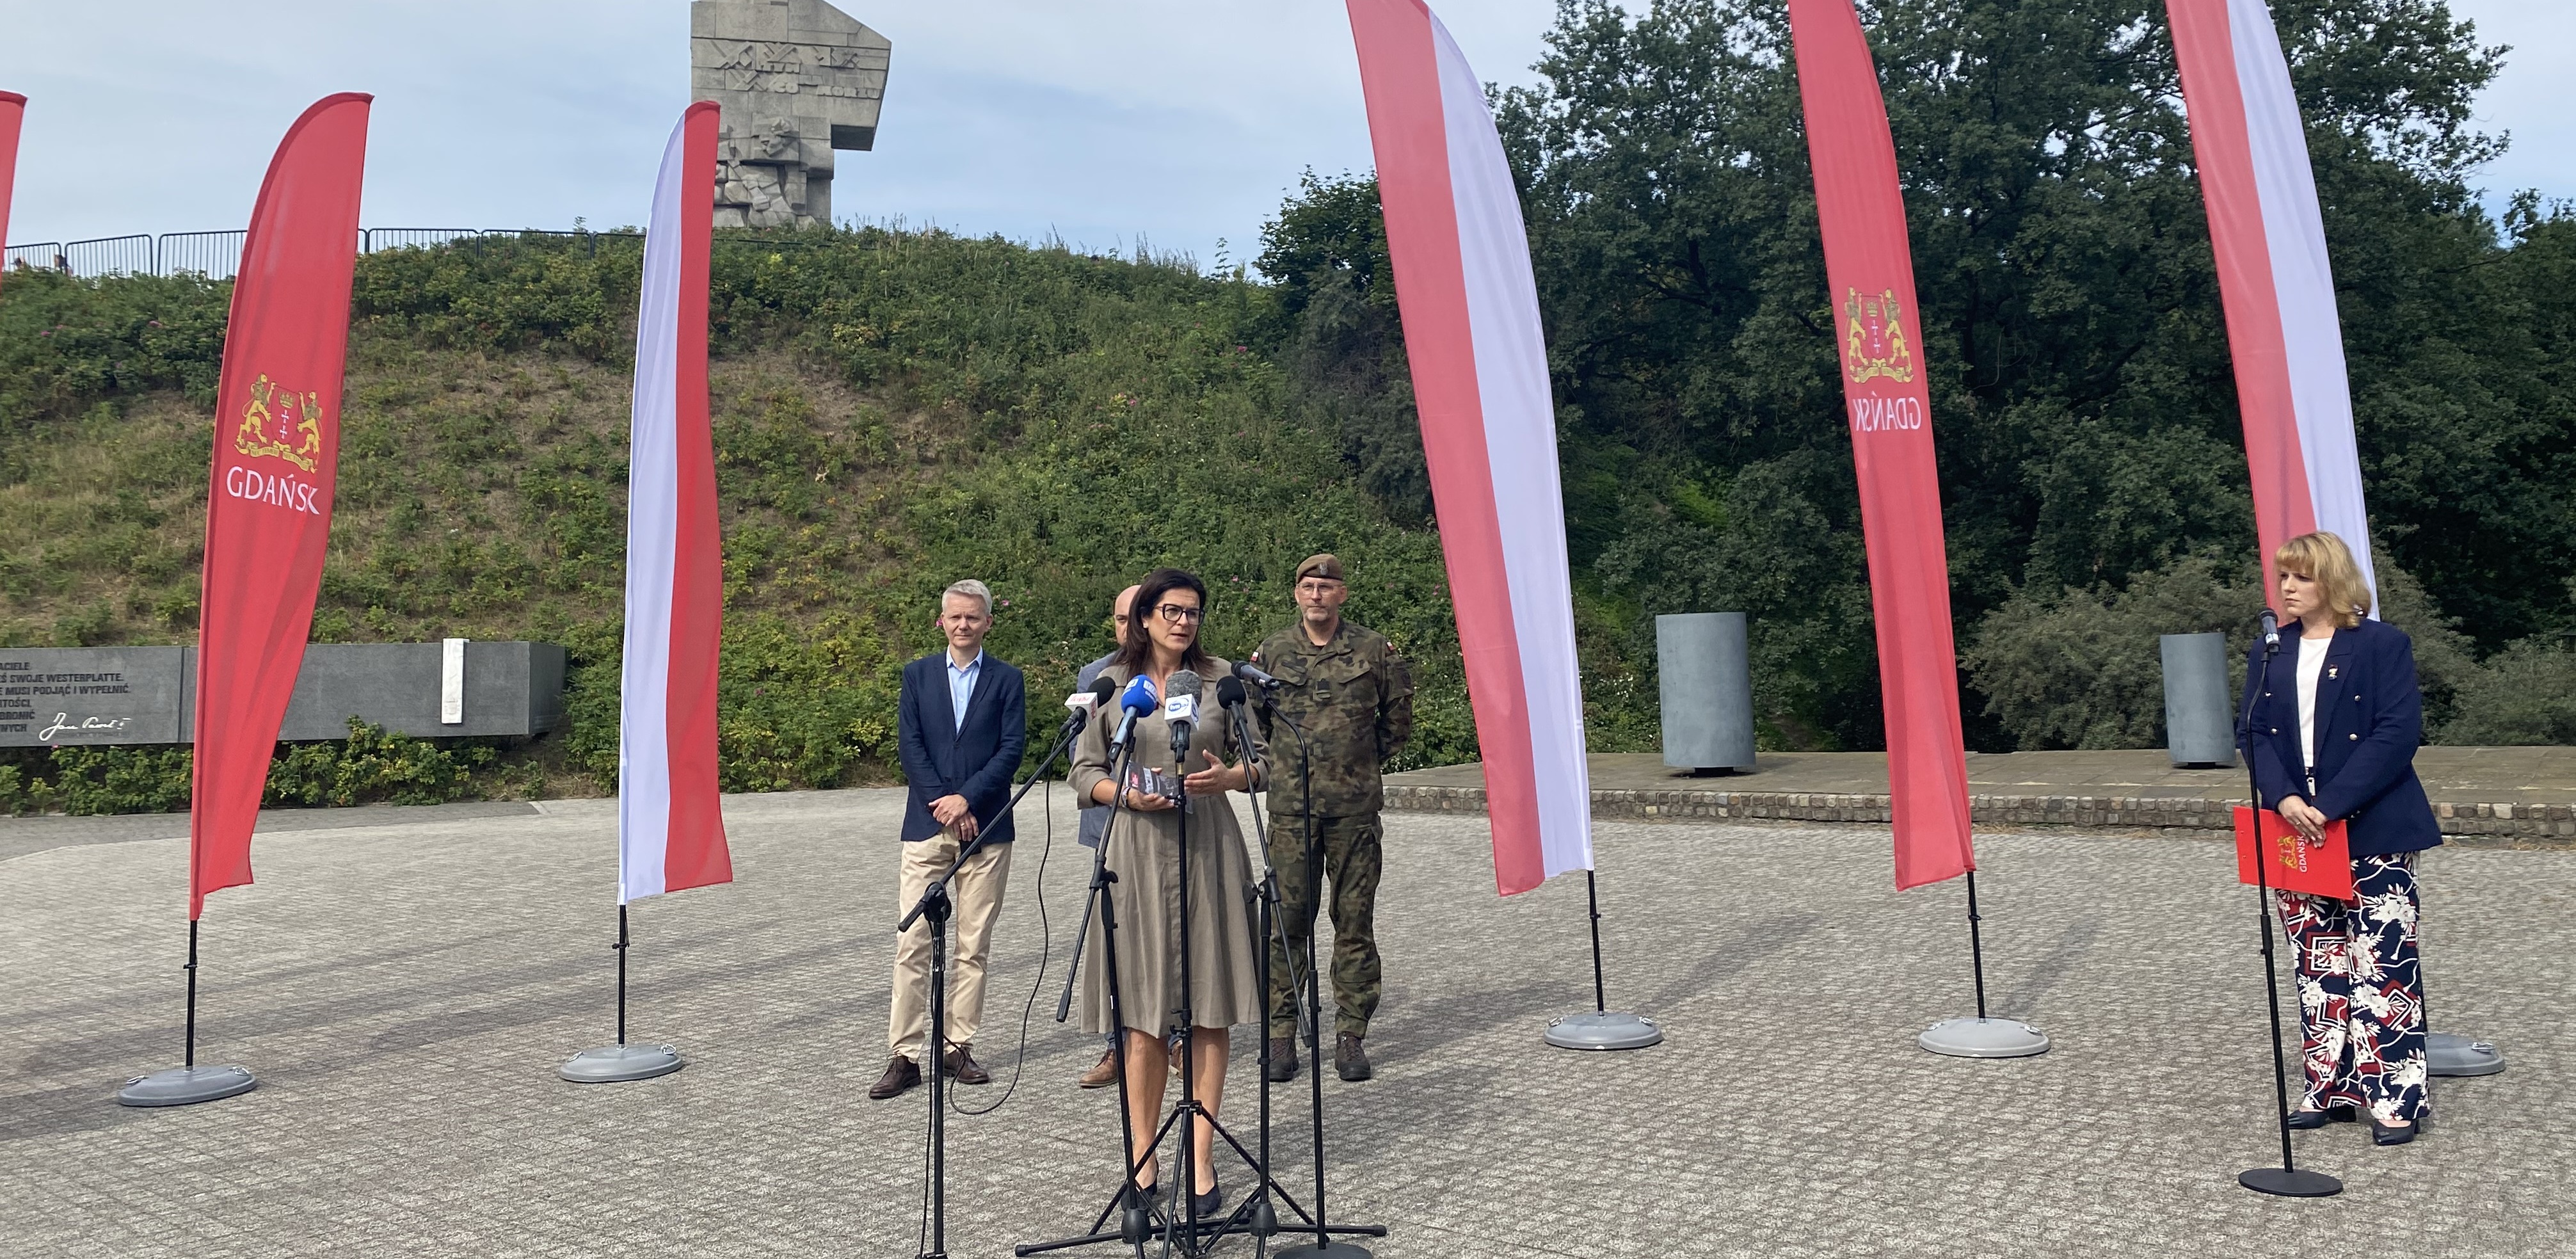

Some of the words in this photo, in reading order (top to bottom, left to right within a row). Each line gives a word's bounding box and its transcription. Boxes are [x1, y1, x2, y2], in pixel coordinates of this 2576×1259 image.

[227, 466, 320, 515] GDAŃSK
[10, 675, 44, 683] SWOJE
[46, 673, 124, 683] WESTERPLATTE.
[5, 687, 30, 695] MUSI
[33, 684, 70, 696] PODJĄĆ
